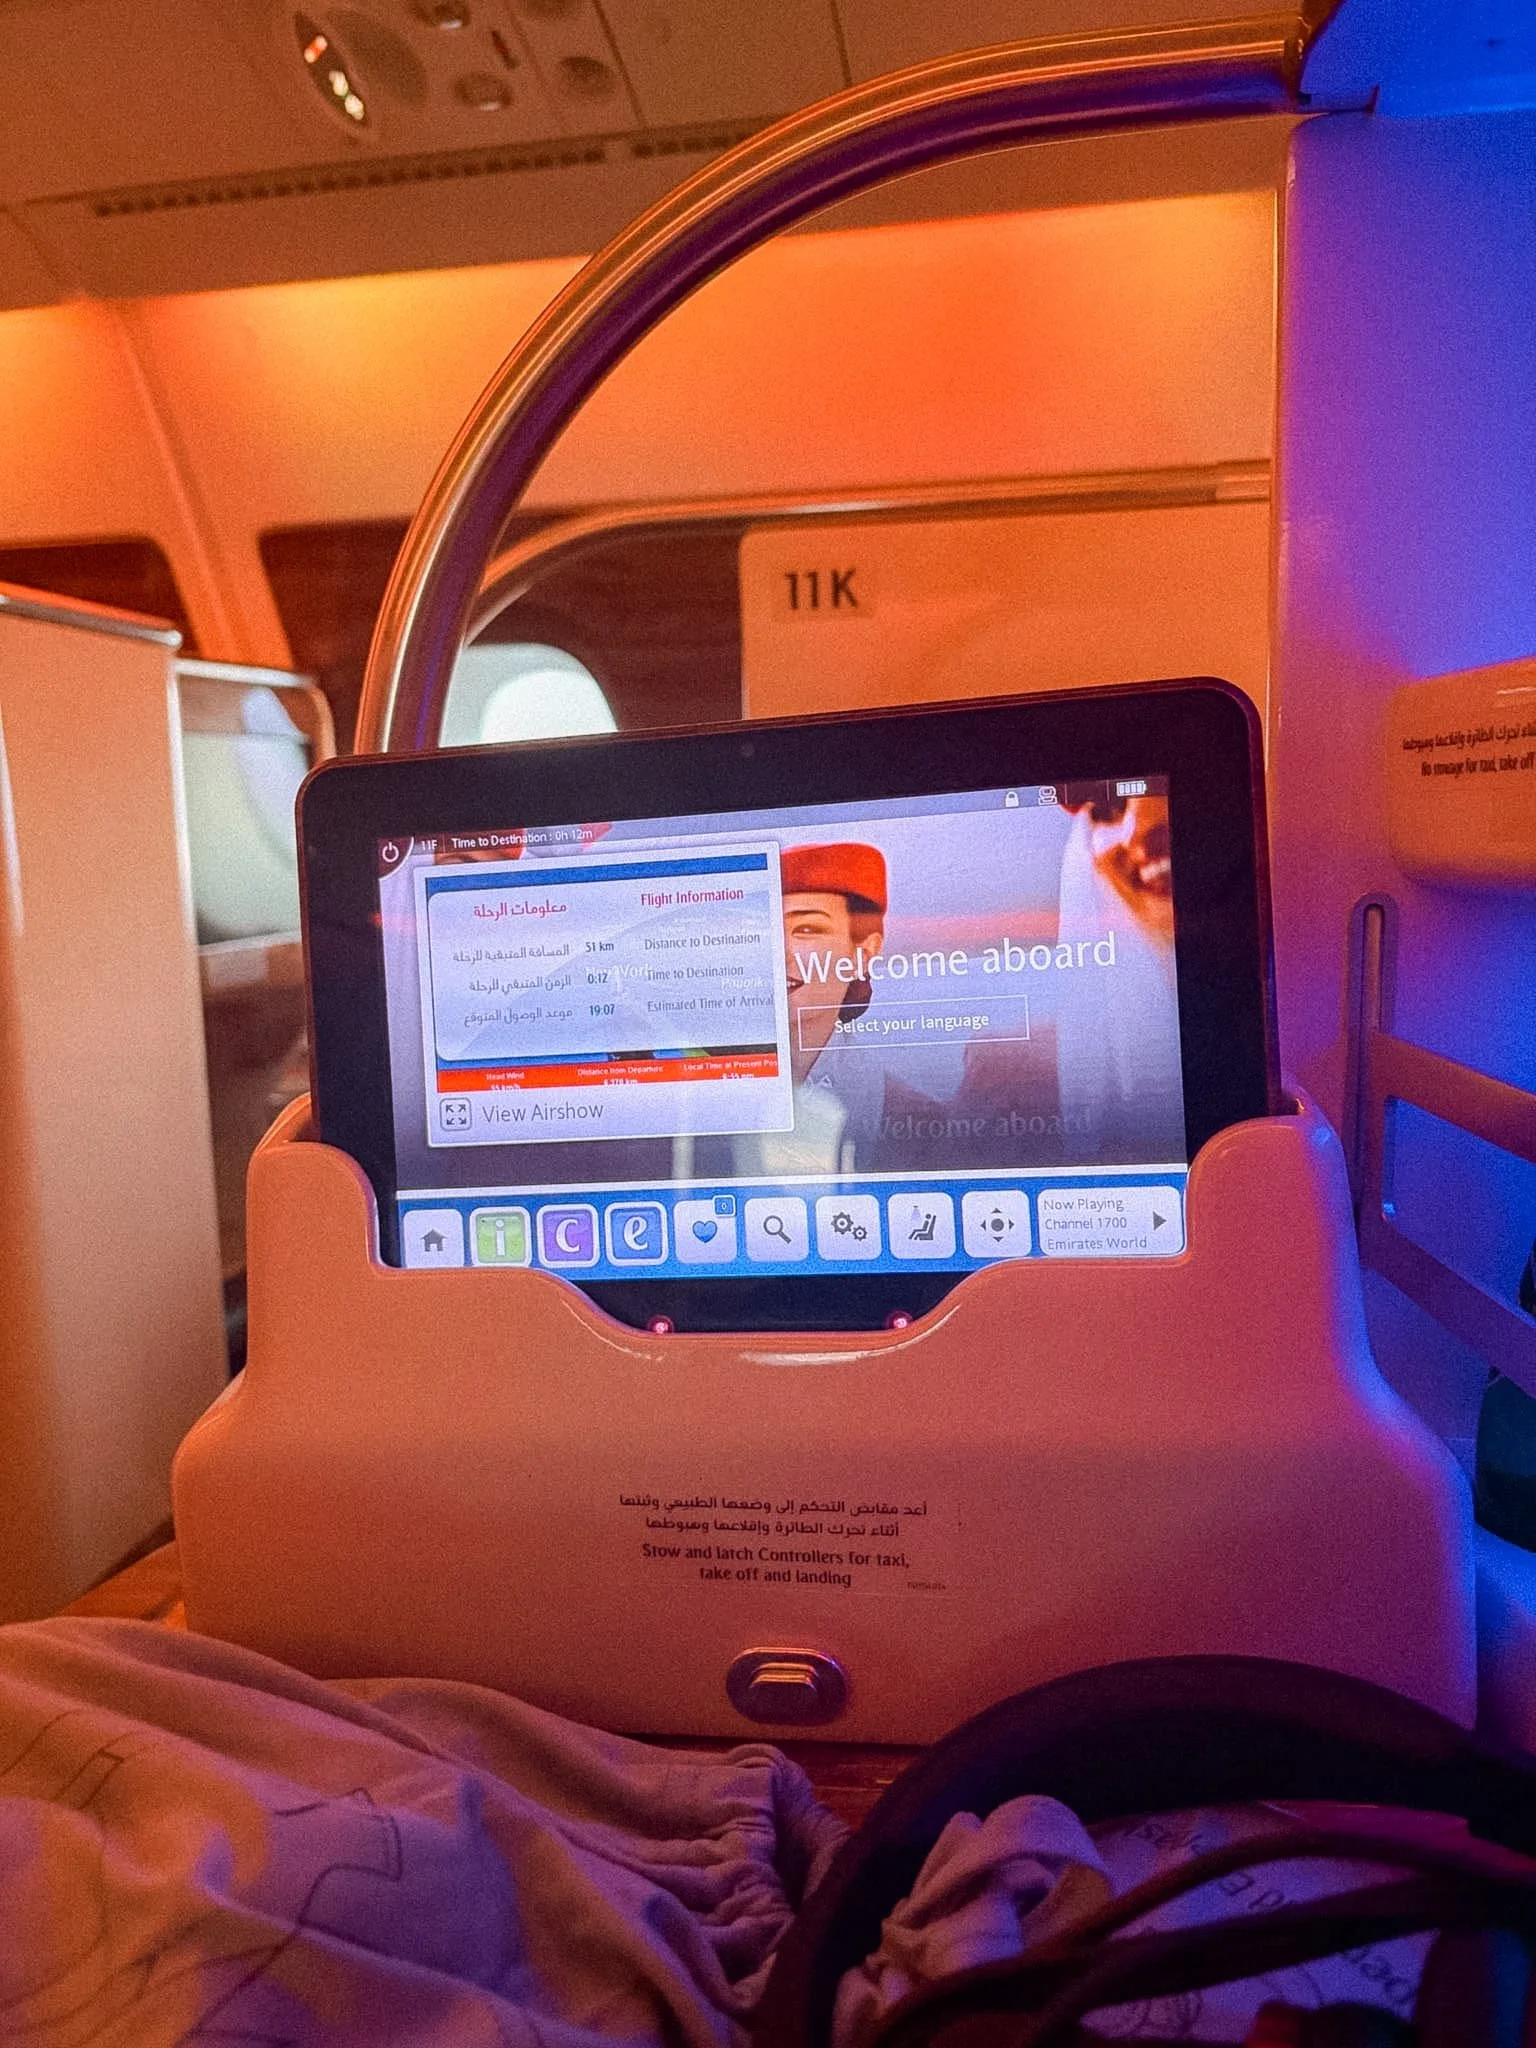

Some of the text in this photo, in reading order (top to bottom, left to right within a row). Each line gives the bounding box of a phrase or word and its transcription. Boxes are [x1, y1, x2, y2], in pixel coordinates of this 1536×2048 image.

[785, 568, 857, 609] 11K
[451, 837, 476, 849] Time
[478, 837, 489, 847] to
[491, 832, 547, 846] Destination
[572, 829, 593, 840] 12m
[640, 887, 744, 908] Flight Information
[473, 900, 567, 921] معلومات الرحلة
[585, 941, 614, 953] 51 km
[644, 933, 761, 950] Distance to Destination
[795, 930, 1117, 984] Welcome aboard
[587, 973, 608, 984] 0:12
[647, 965, 744, 981] Time to Destination
[589, 1003, 615, 1016] 19:07
[647, 993, 774, 1012] Estimated Time of Arrival
[834, 1013, 990, 1036] Select your language
[483, 1101, 604, 1123] View Airshow
[1043, 1198, 1124, 1213] Now Playing
[1045, 1216, 1127, 1230] Channel 1700
[1048, 1236, 1147, 1250] Emirates World
[722, 1497, 772, 1513] وضعها
[776, 1499, 794, 1515] إلى
[799, 1500, 845, 1515] التحكم
[850, 1502, 898, 1517] مقابض
[903, 1501, 928, 1516] أعد
[646, 1516, 709, 1533] وهبوطها
[775, 1521, 823, 1537] الطائرة
[827, 1523, 866, 1539] تحرك
[870, 1522, 899, 1537] أثناء
[642, 1543, 911, 1569] Stow and latch Controllers for taxi,
[700, 1566, 852, 1588] take off and landing
